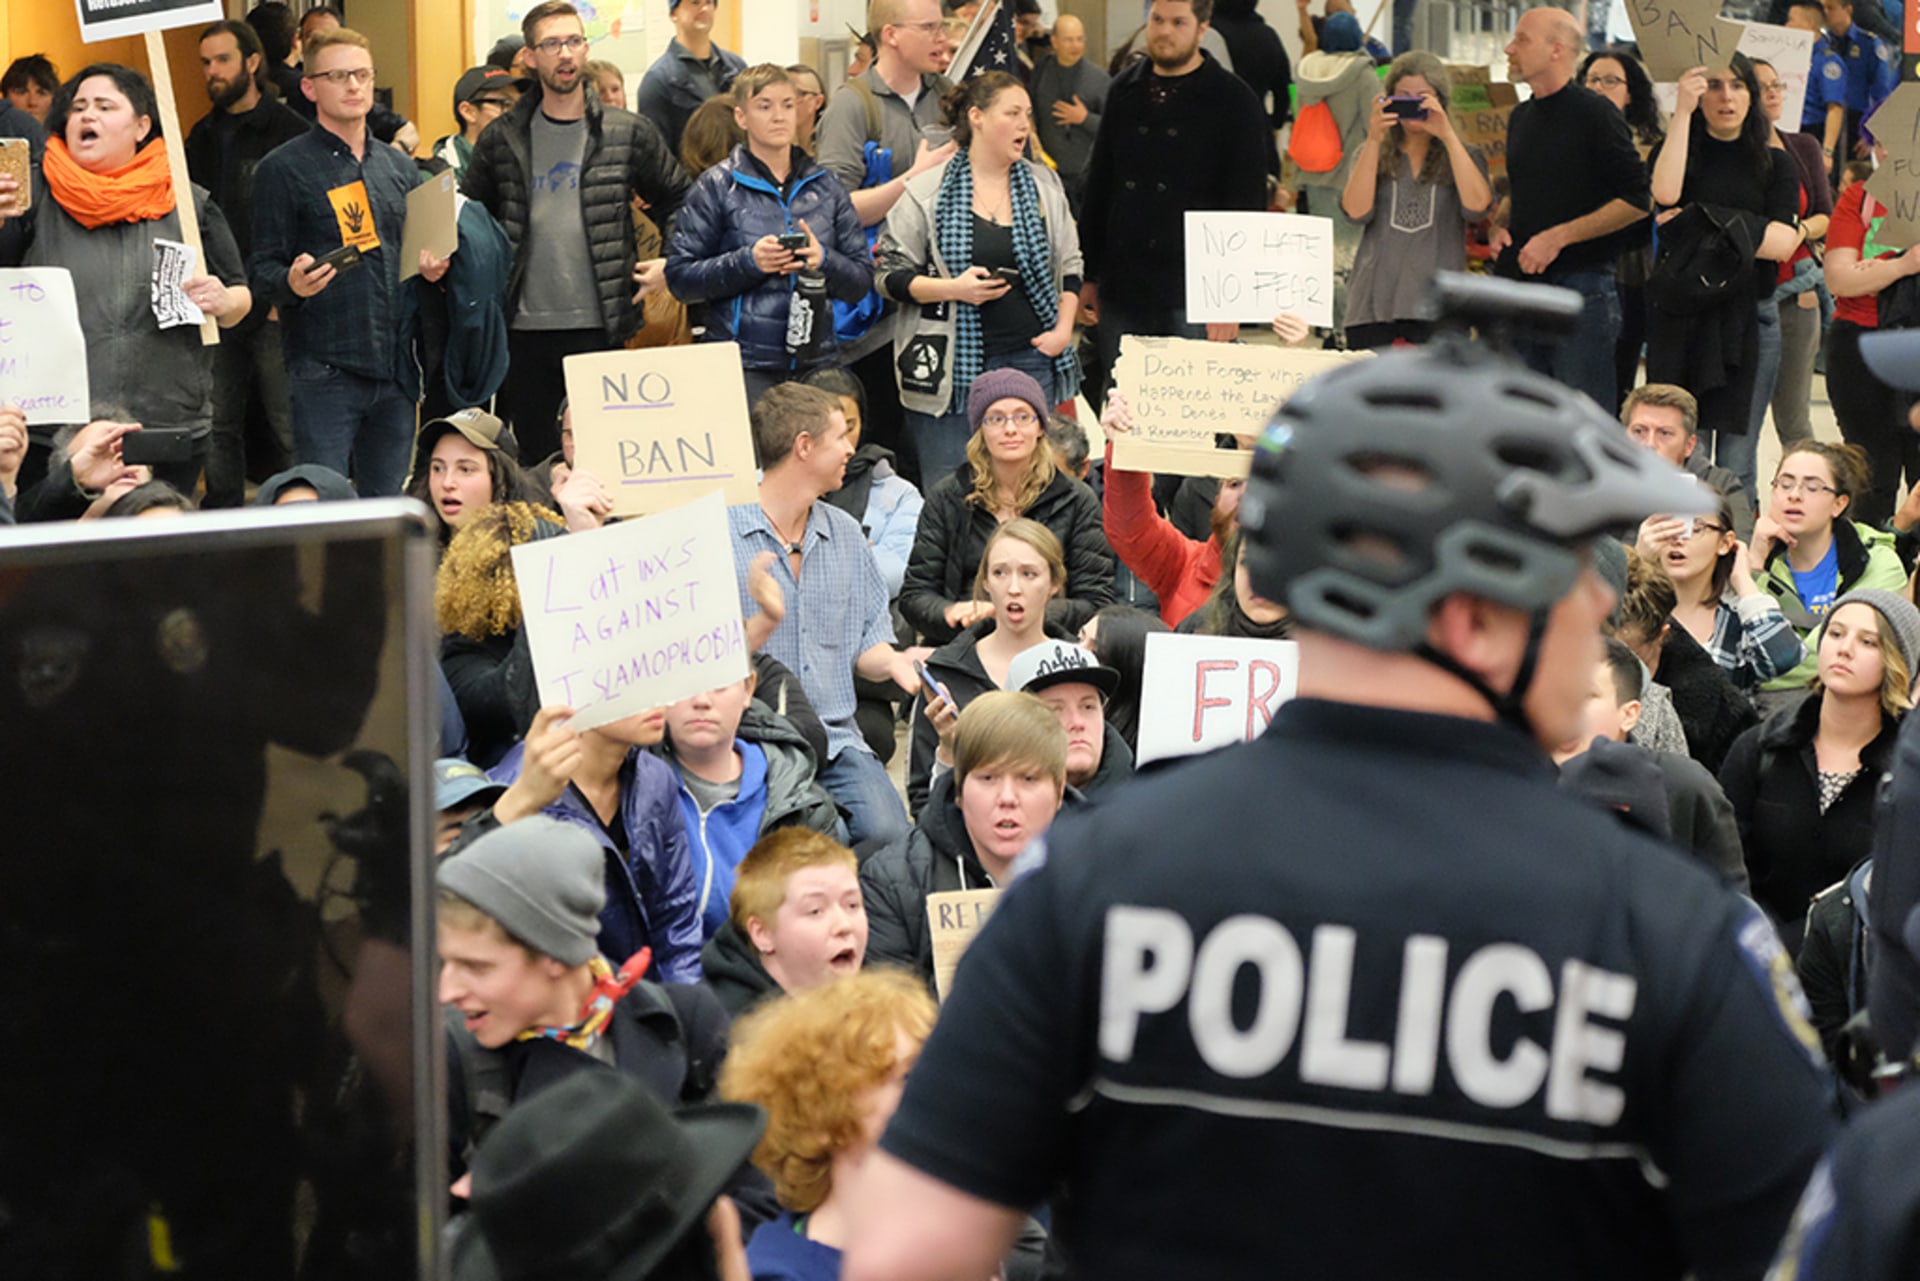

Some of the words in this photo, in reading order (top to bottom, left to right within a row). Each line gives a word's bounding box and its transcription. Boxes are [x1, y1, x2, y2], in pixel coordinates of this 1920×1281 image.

[1202, 222, 1247, 257] NO
[1202, 269, 1242, 309] NO
[602, 372, 671, 403] NO
[618, 432, 715, 478] BAN
[572, 581, 701, 654] AGAINST
[1192, 659, 1281, 742] FR
[1097, 904, 1638, 1127] POLICE
